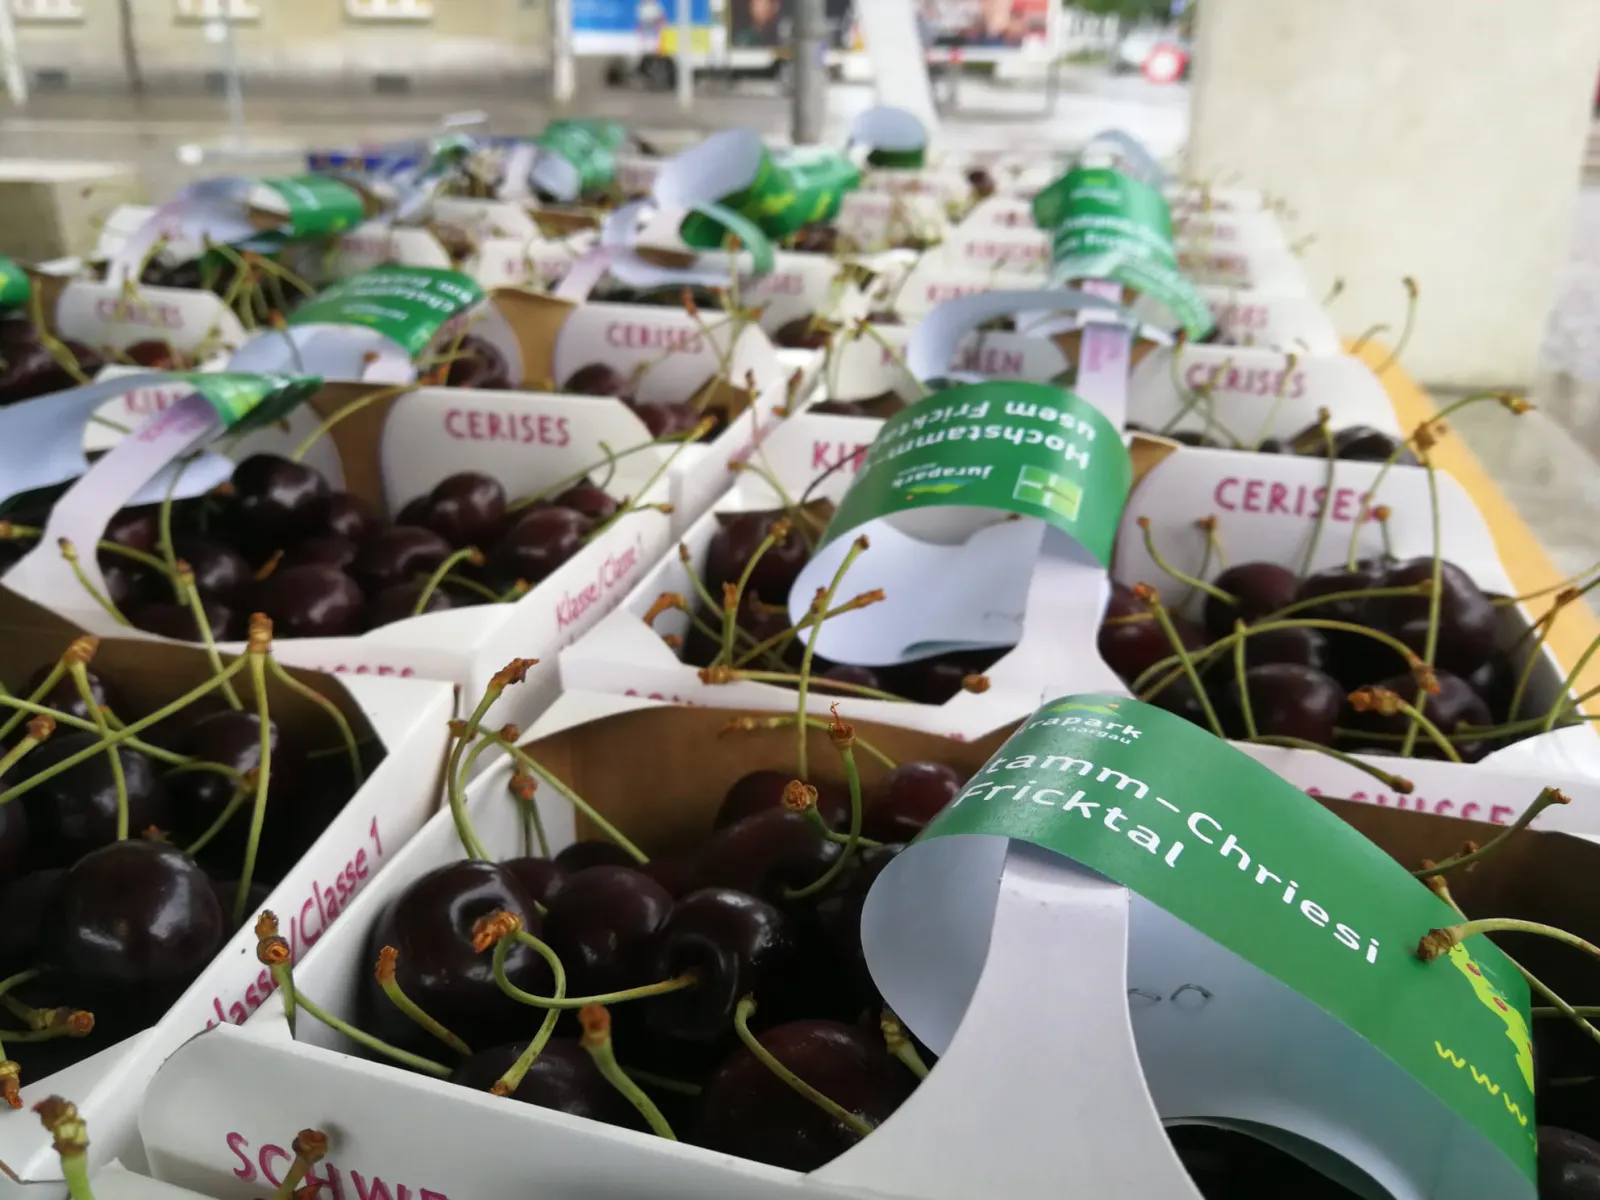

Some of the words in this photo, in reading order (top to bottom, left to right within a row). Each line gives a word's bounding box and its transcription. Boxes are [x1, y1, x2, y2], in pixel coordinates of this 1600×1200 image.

[444, 408, 571, 448] CERISES
[1004, 400, 1096, 441] usem
[866, 423, 1090, 471] Hochstamm-
[1214, 476, 1384, 523] CERISES
[1016, 716, 1143, 739] rapark
[1066, 726, 1132, 745] aargau
[951, 780, 1186, 869] Fricktal
[976, 754, 1381, 965] tamm-Chriesi
